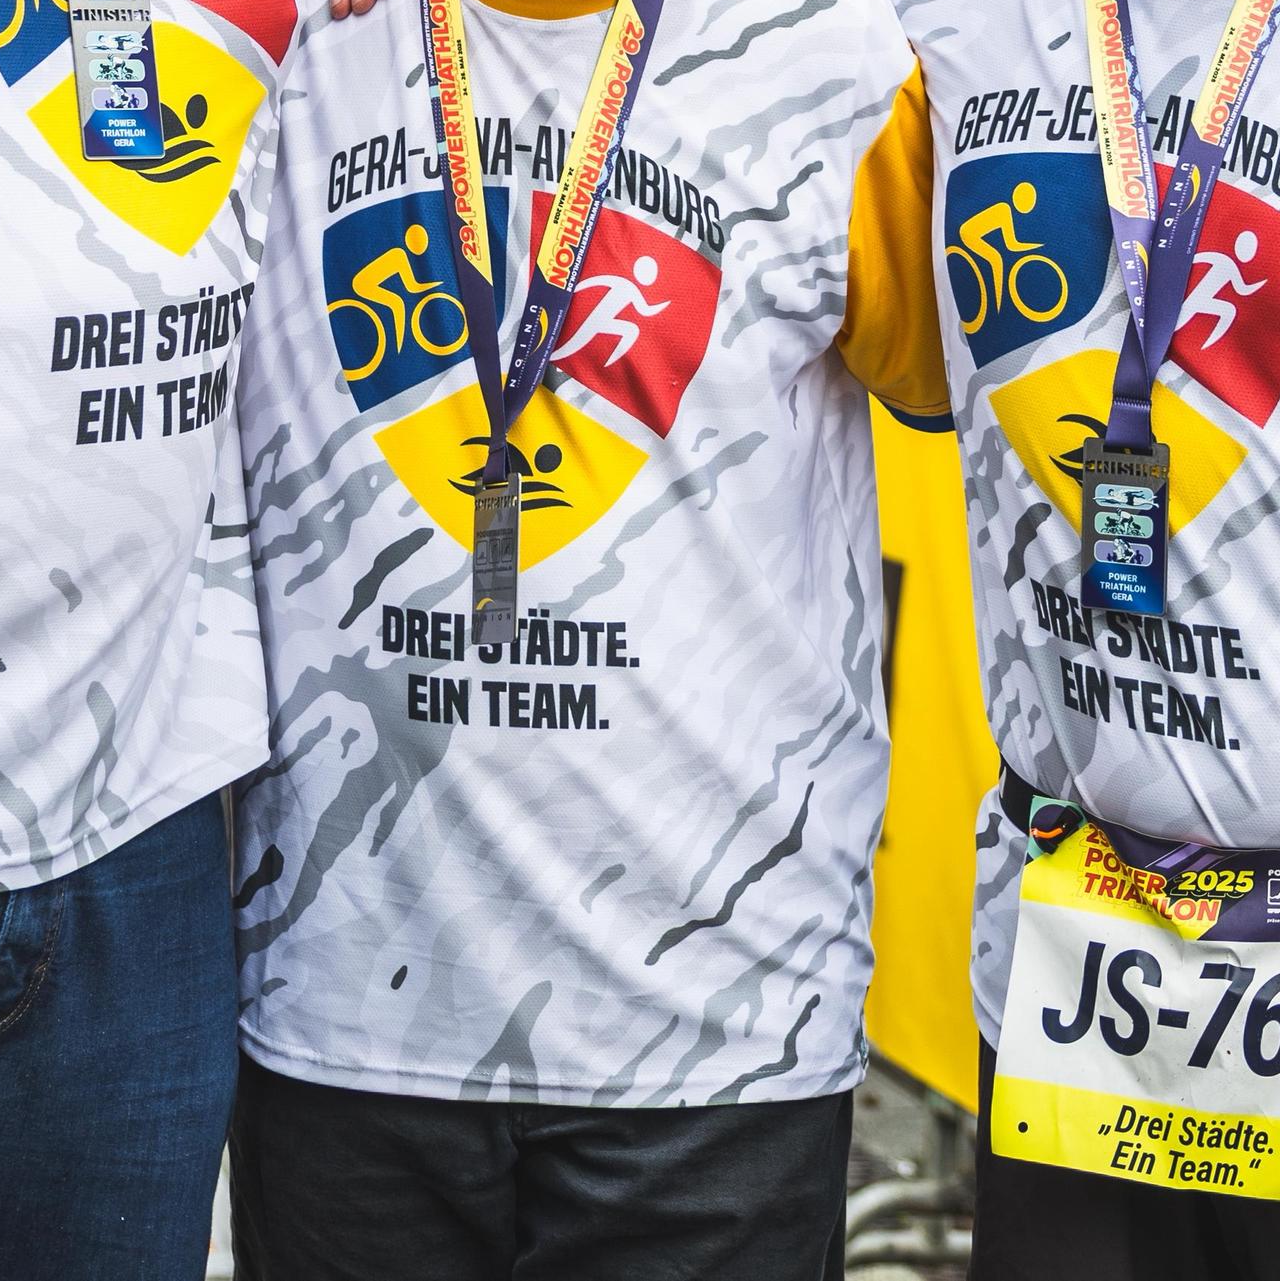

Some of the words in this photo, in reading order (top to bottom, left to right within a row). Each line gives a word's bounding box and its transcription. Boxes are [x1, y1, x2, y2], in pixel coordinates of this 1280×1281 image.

[619, 21, 644, 56] 29.
[108, 119, 137, 128] POWER
[1100, 2, 1147, 217] POWERTRIATHLON
[1220, 57, 1260, 149] WWW.POWERTRIATHLON.DE
[101, 128, 146, 137] TRIATHLON
[114, 138, 135, 148] GERA
[548, 61, 632, 288] POWERTRIATHLON
[567, 200, 601, 292] WWW.POWERTRIATHLON.DE
[51, 308, 146, 372] DREI
[75, 385, 145, 445] EIN
[1100, 581, 1147, 594] TRIATHLON
[1108, 572, 1138, 583] POWER
[1112, 591, 1133, 602] GERA
[382, 604, 466, 662] DREI
[1030, 577, 1097, 652] DREI
[407, 673, 470, 726] EIN
[482, 680, 610, 731] TEAM.
[1059, 655, 1111, 724] EIN
[1114, 675, 1241, 751] TEAM.
[1178, 870, 1255, 893] 2025
[1097, 1104, 1174, 1142] „Drei
[1178, 1118, 1275, 1155] Städte.
[1110, 1140, 1156, 1175] Ein
